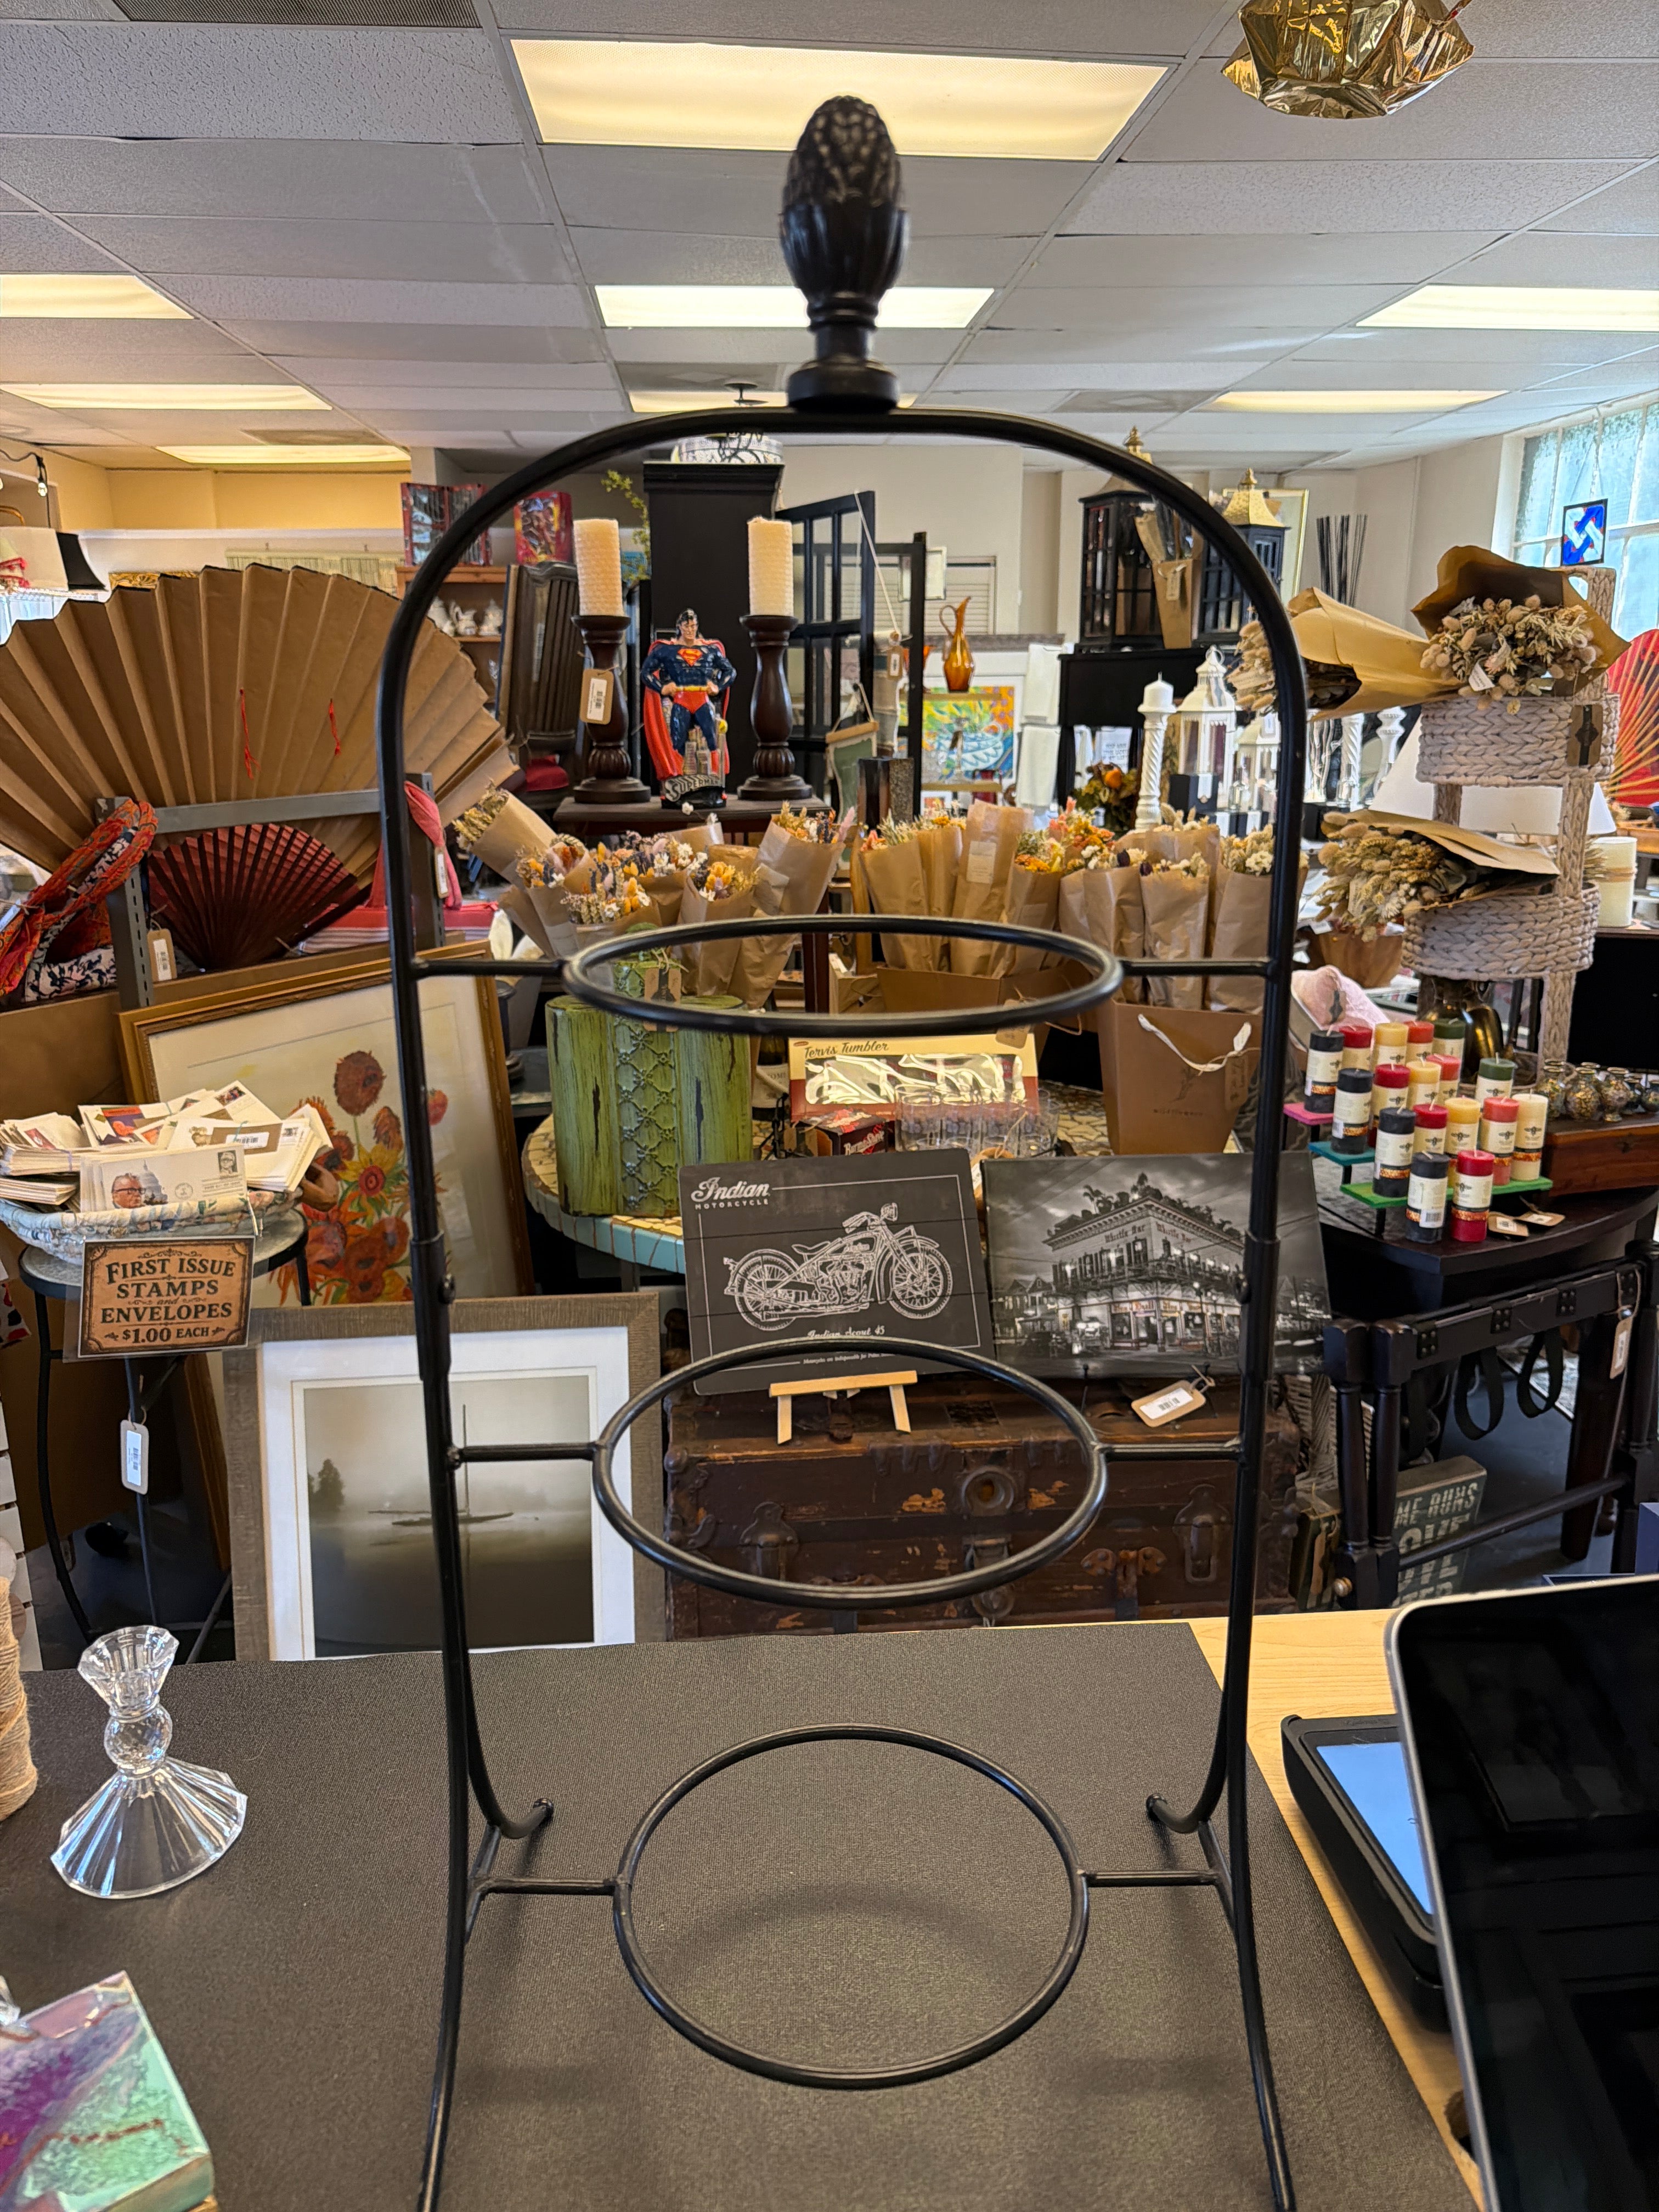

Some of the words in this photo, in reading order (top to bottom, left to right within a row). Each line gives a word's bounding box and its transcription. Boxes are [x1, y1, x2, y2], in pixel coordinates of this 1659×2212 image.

[805, 1046, 837, 1059] Tervis
[842, 1040, 889, 1054] Tumbler
[691, 1177, 770, 1203] Indian
[695, 1198, 769, 1210] MOTORCYCLE
[105, 1258, 170, 1285] FIRST
[178, 1258, 236, 1277] ISSUE
[116, 1279, 218, 1299] STAMPS
[100, 1302, 232, 1324] ENVELOPES
[122, 1327, 172, 1344] $1.00
[176, 1327, 210, 1339] EACH
